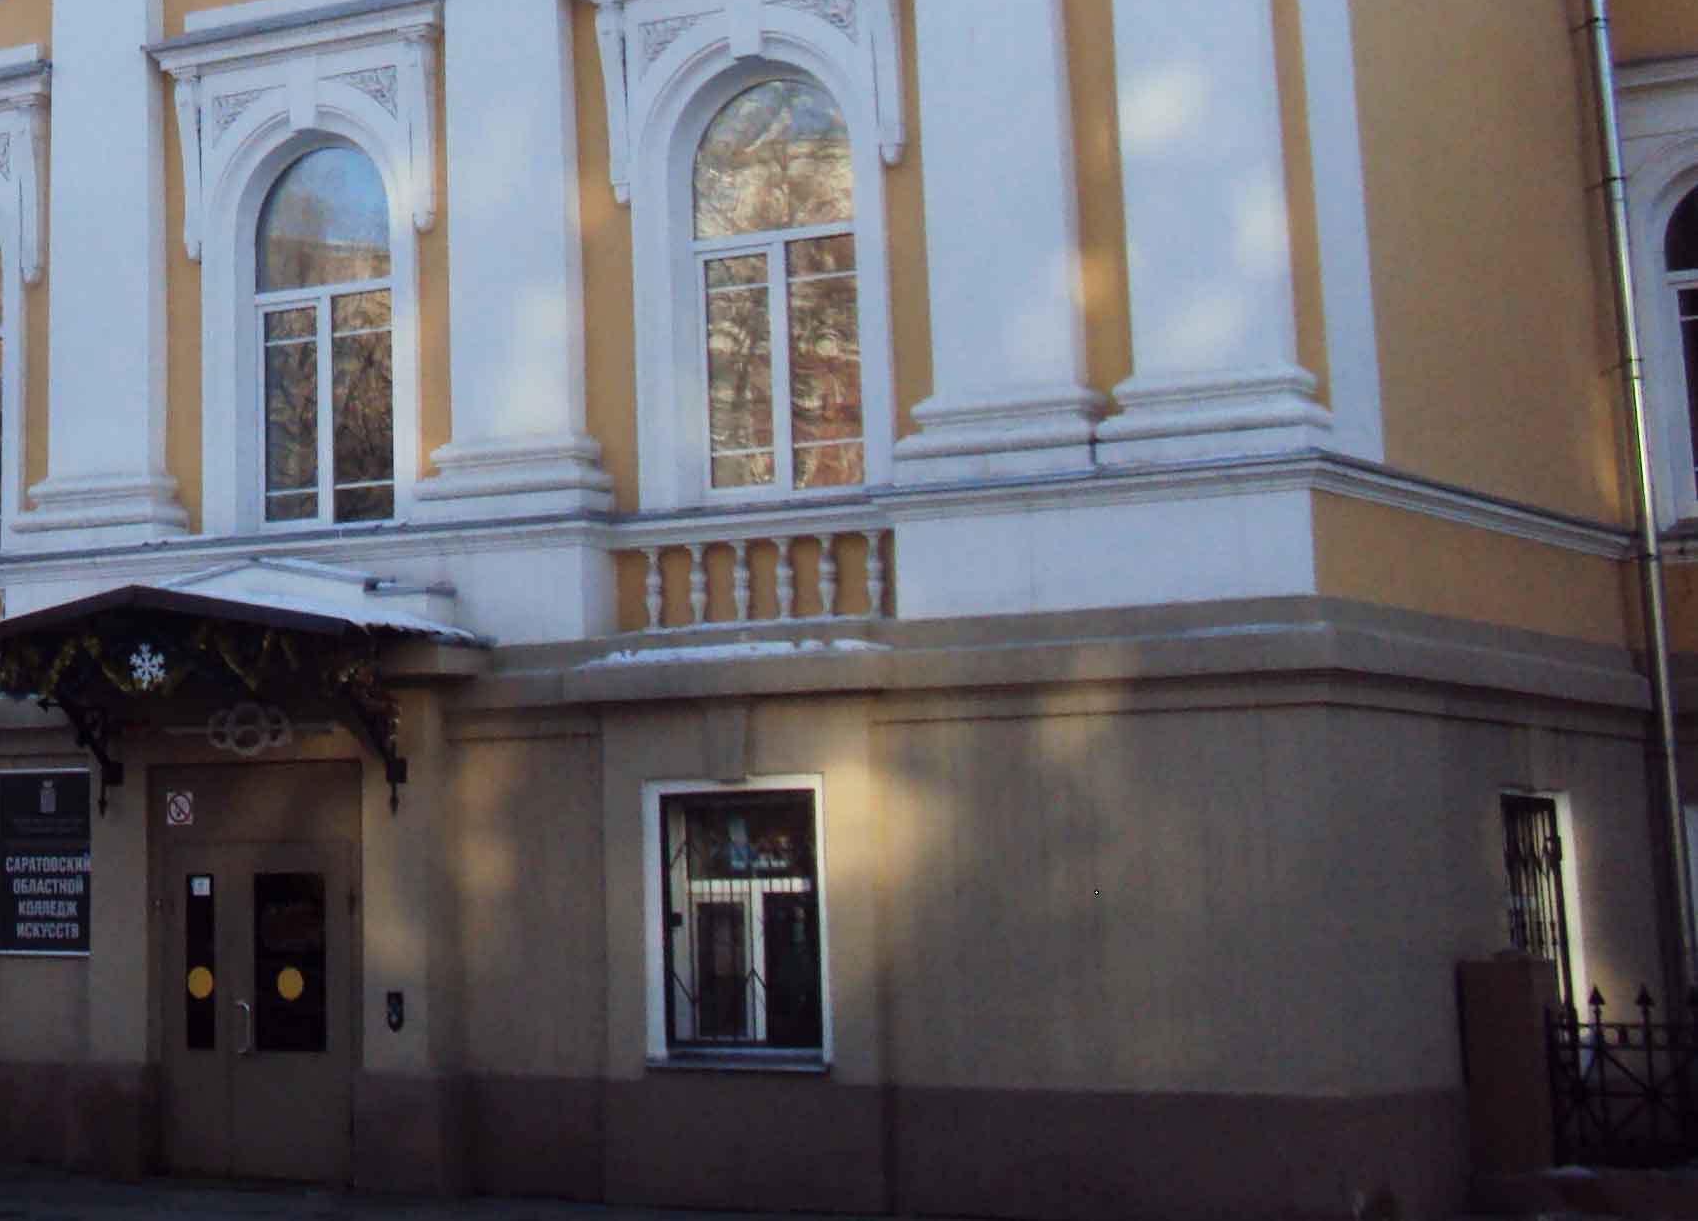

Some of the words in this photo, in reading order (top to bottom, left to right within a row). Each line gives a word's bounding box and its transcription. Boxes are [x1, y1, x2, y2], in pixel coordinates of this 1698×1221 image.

[13, 876, 84, 894] ОБЛАСТНОЙ
[18, 900, 78, 917] КОЛЛЕДЖ
[16, 922, 79, 939] ИСКУССТВ
